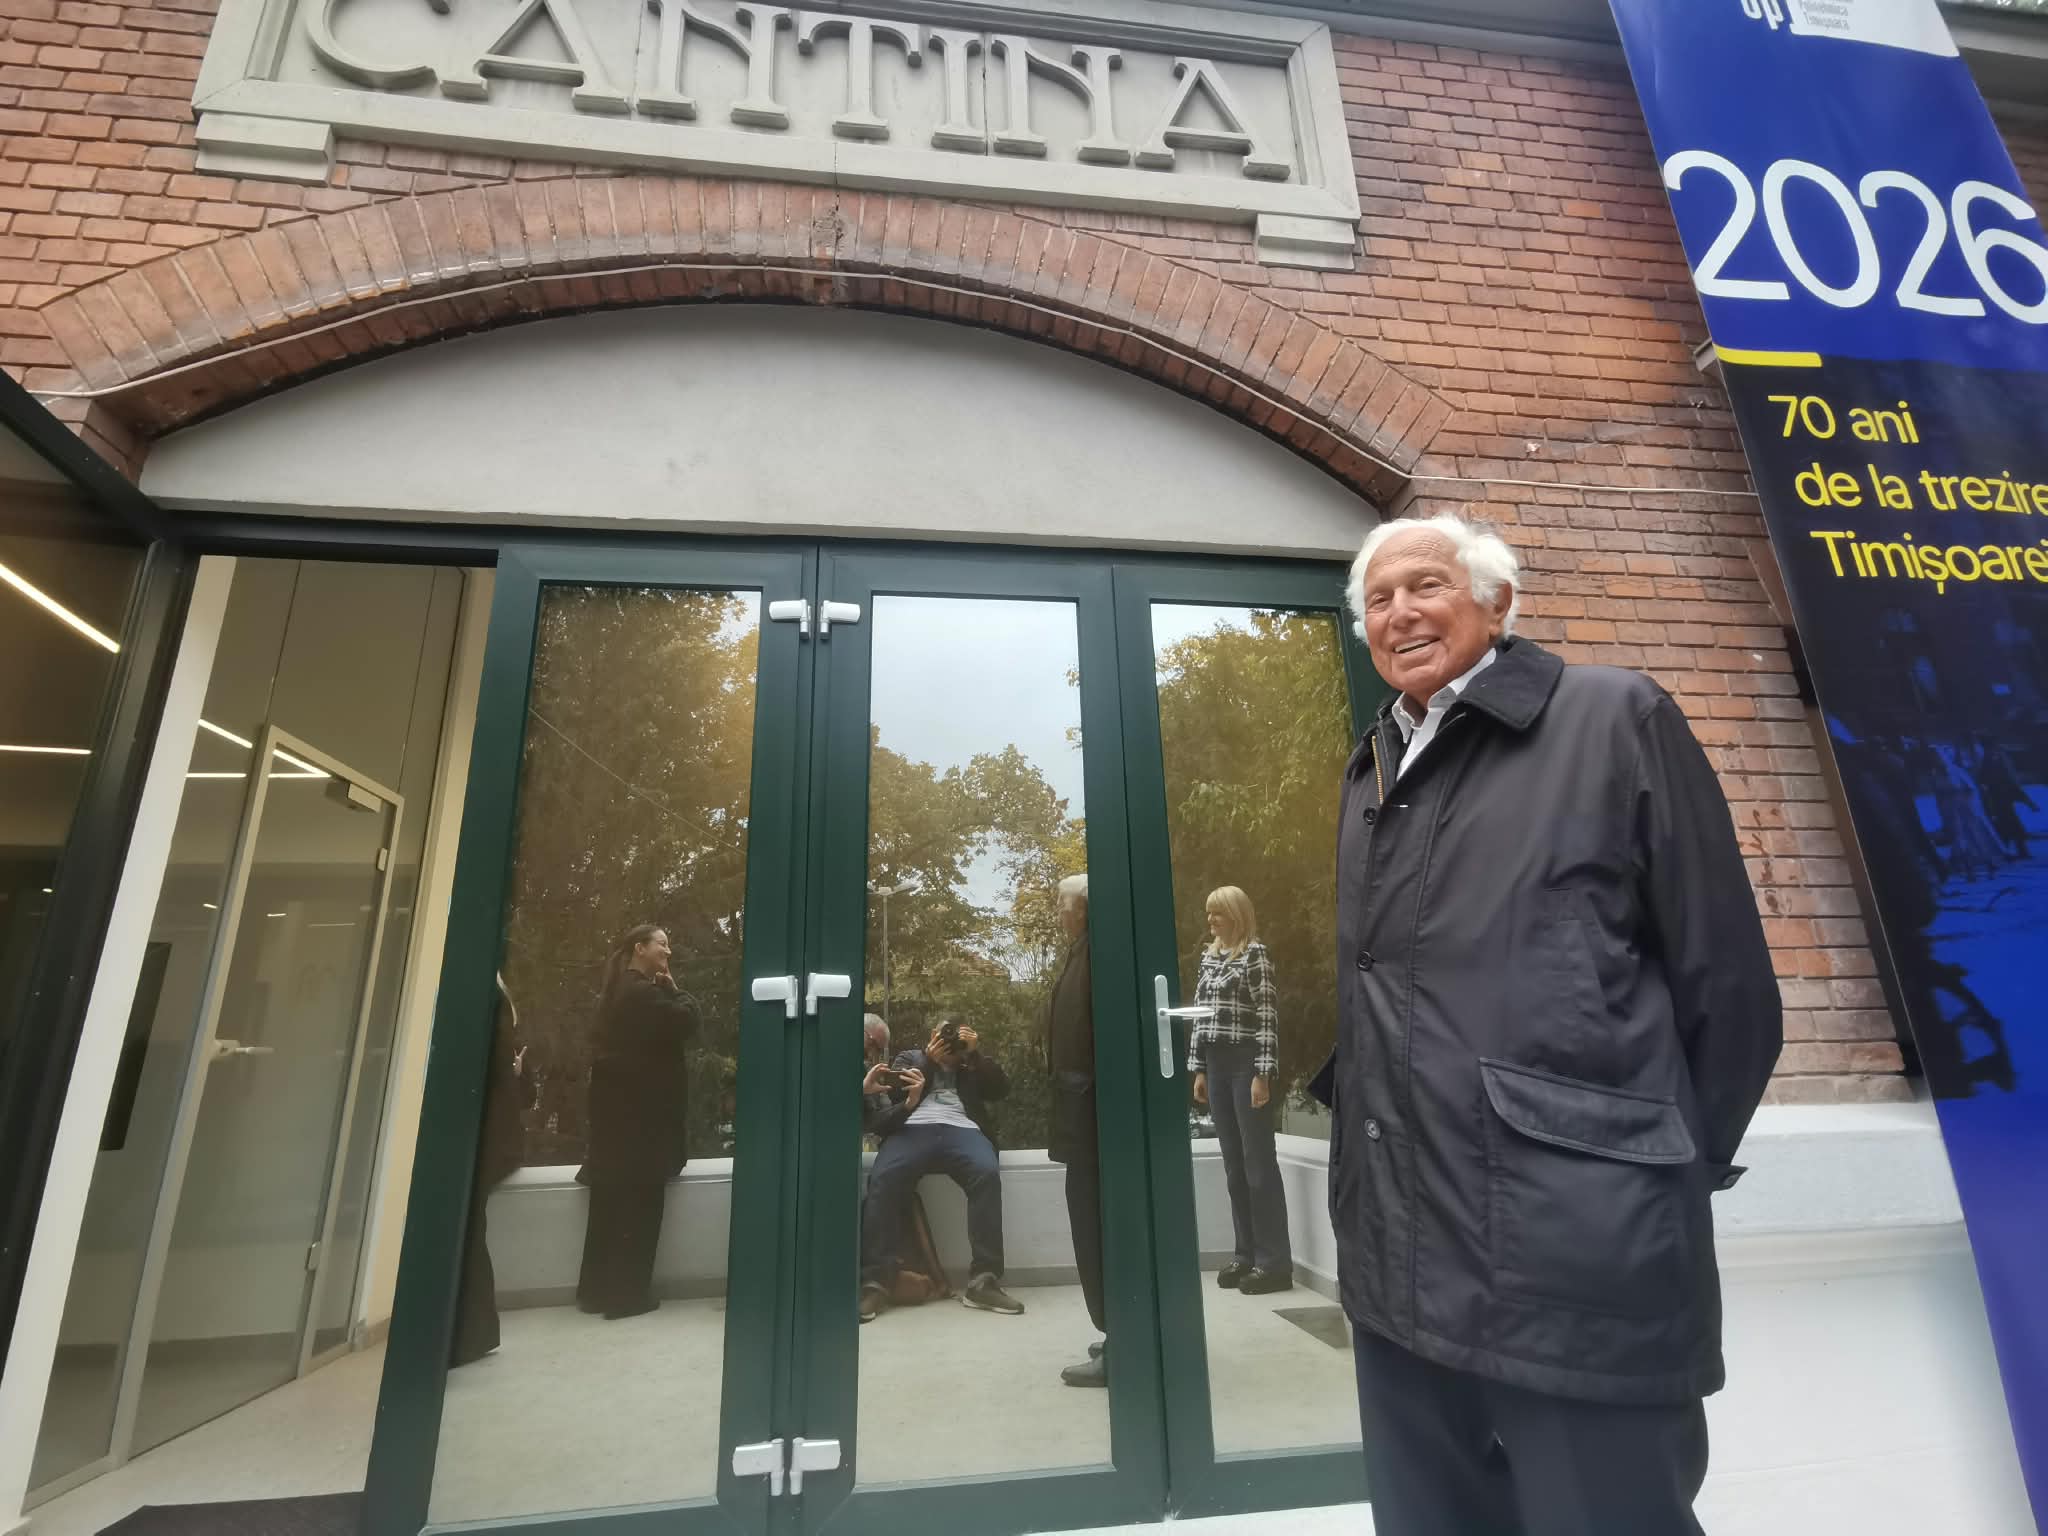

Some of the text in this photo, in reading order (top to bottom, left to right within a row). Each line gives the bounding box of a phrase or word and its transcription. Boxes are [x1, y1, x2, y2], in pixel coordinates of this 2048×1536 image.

[306, 0, 1291, 180] CANTINA
[1663, 150, 2048, 325] 2026
[1767, 395, 1920, 444] 70 ani
[1795, 462, 1863, 507] de
[1867, 463, 1914, 510] la
[1809, 530, 2048, 595] Timișoare
